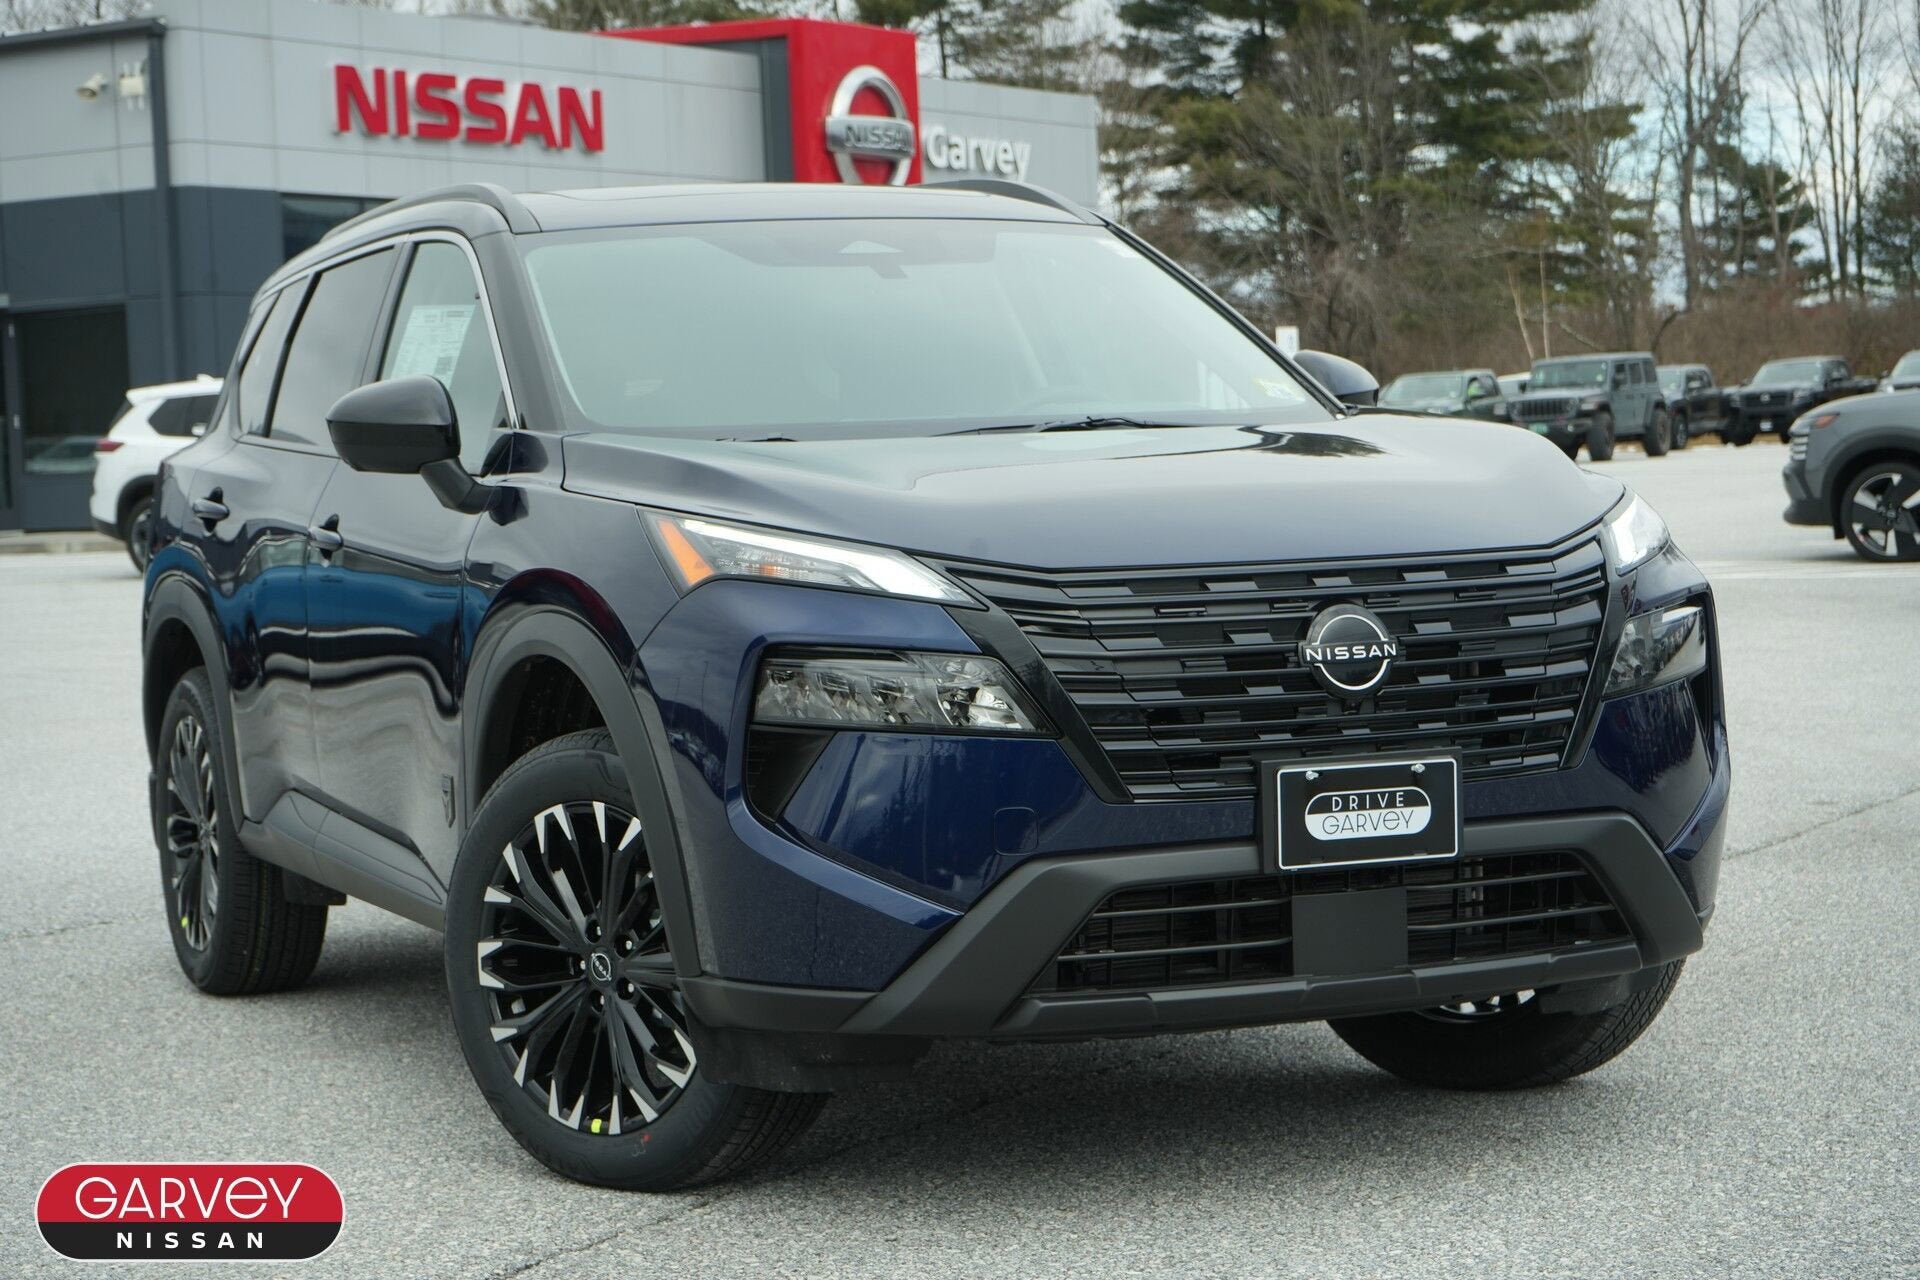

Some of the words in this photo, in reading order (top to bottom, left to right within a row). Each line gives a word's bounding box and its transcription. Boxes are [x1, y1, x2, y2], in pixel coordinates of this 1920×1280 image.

[335, 65, 604, 152] NISSAN
[926, 126, 1032, 182] Garvey
[1305, 643, 1397, 661] NISSAN
[1332, 791, 1404, 812] DRIVE
